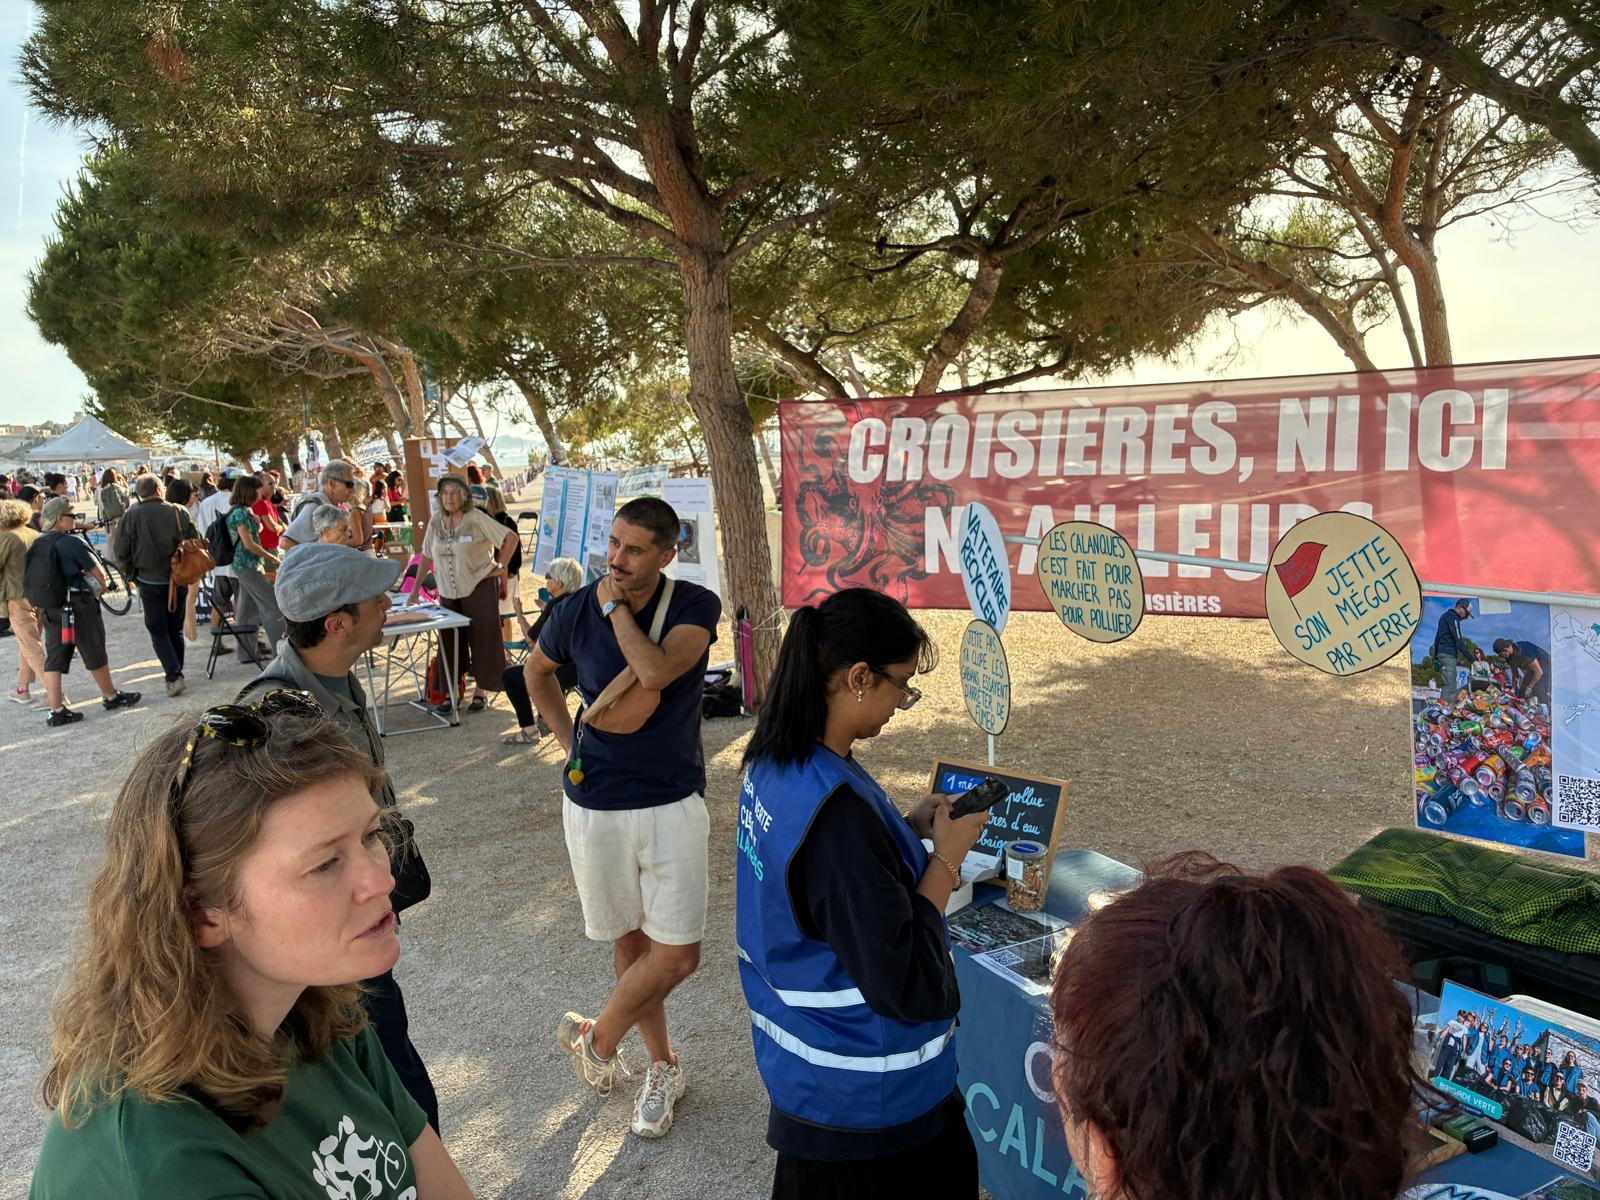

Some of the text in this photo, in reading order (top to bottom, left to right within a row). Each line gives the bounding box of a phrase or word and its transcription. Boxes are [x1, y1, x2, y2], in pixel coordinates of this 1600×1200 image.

[847, 389, 1509, 484] CROISIÈRES, NI ICI
[924, 502, 1373, 582] N ALEU
[1049, 531, 1125, 559] LES CALANQUES
[1041, 556, 1068, 576] C'EST
[1104, 563, 1133, 585] POUR
[1325, 536, 1391, 596] JETTE
[960, 536, 997, 626] RECYCLER
[1051, 579, 1131, 609] MARCHER PAS
[1145, 591, 1221, 613] ISIÈRES
[1294, 567, 1401, 651] SON MÉGOT
[1062, 605, 1132, 634] POUR POLLUER
[1326, 603, 1418, 673] PAR TERRE
[992, 658, 1003, 679] LES
[975, 704, 995, 732] FUMER
[997, 702, 1005, 720] DE
[947, 774, 956, 790] 1
[1005, 786, 1044, 815] pollue
[1473, 1097, 1497, 1114] VERTE
